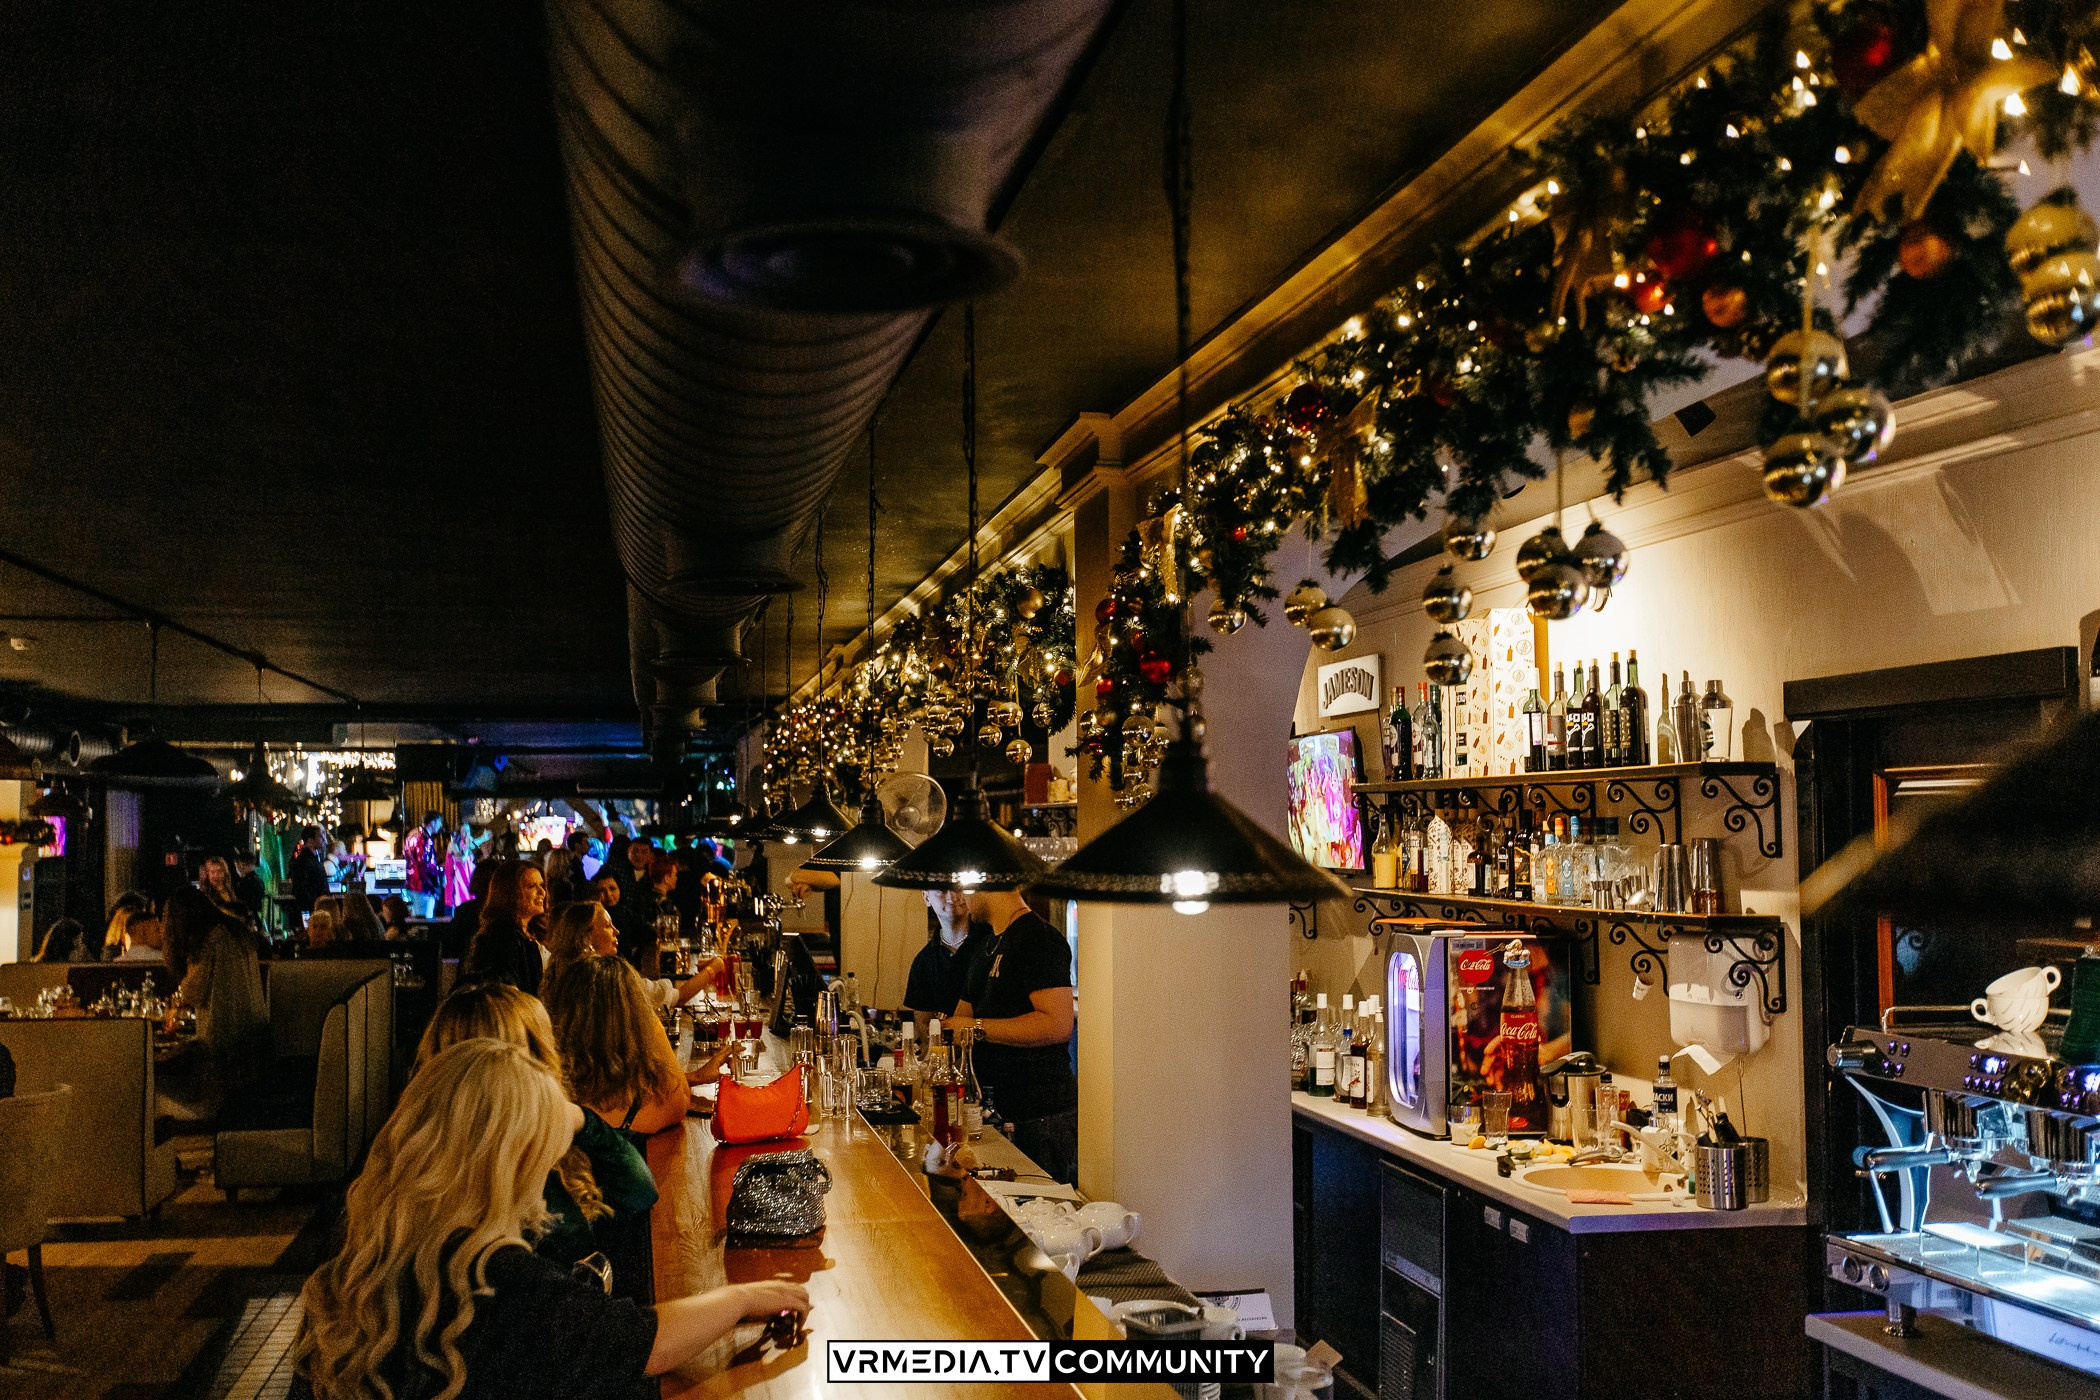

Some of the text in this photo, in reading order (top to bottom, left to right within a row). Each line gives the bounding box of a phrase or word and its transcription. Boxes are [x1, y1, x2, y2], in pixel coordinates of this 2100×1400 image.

[1322, 666, 1374, 709] JAMESON
[1460, 958, 1493, 971] Coca-Cola
[1501, 1022, 1538, 1040] Coca-Cola
